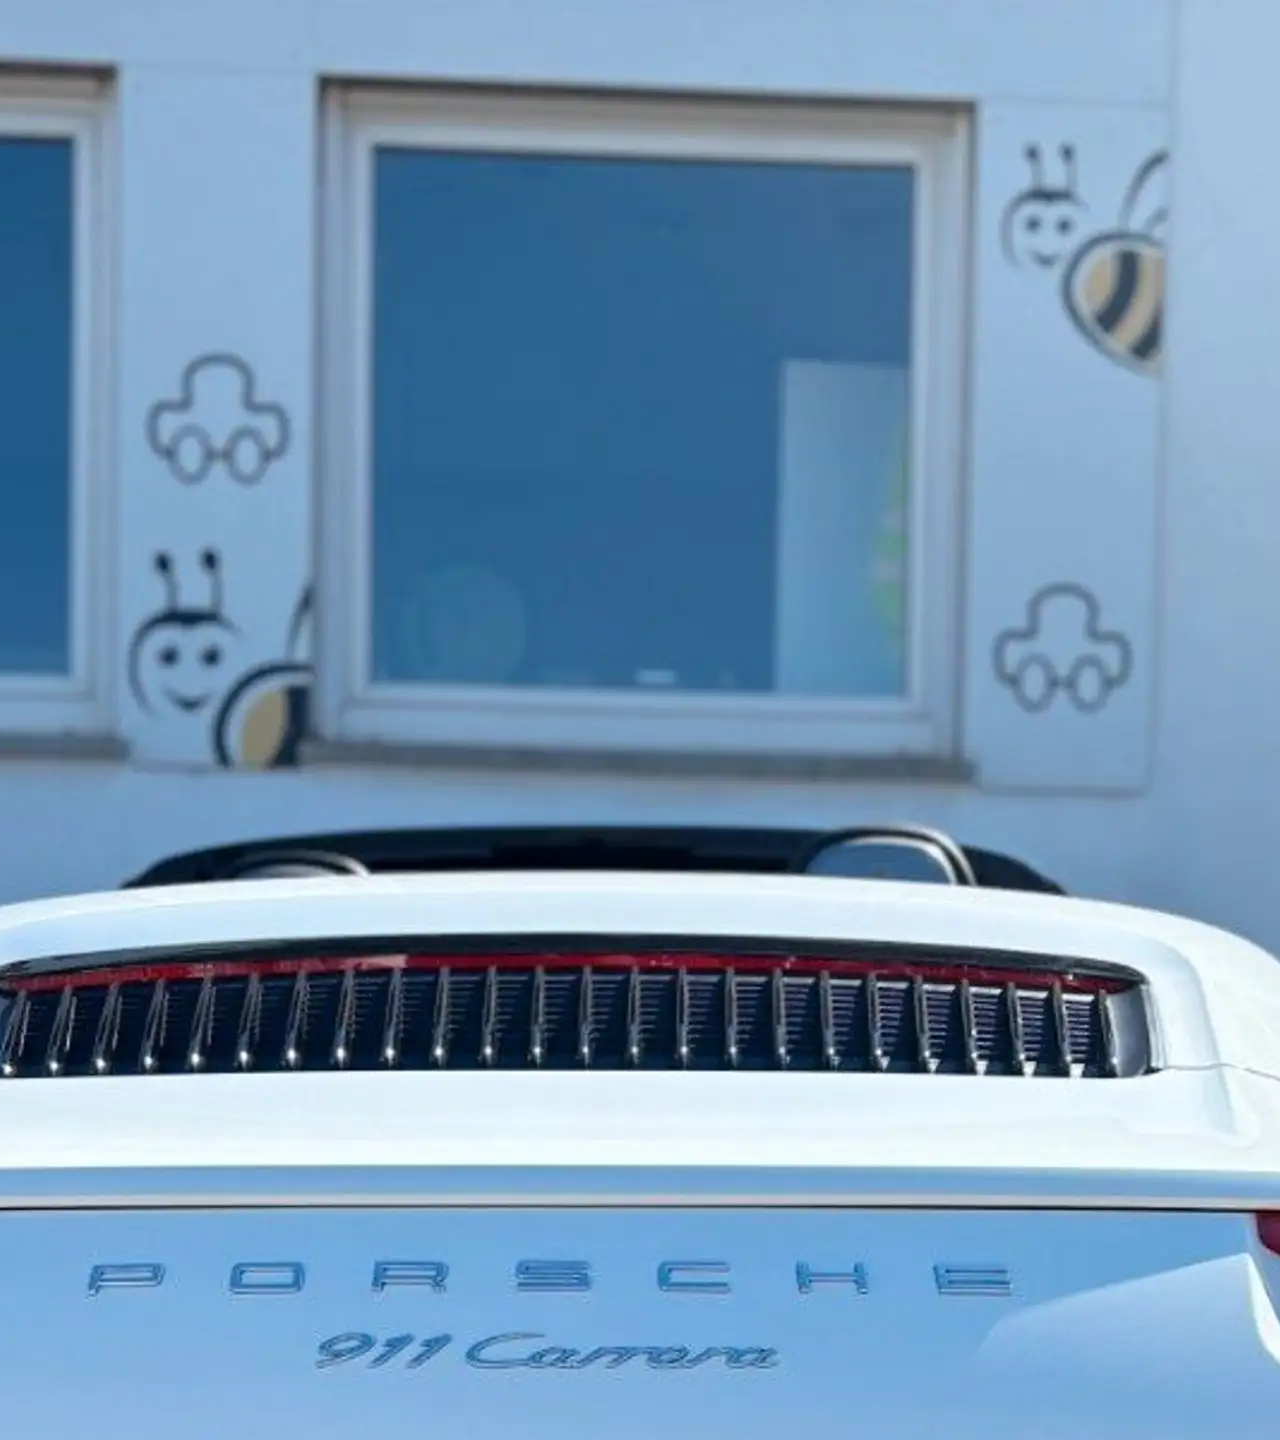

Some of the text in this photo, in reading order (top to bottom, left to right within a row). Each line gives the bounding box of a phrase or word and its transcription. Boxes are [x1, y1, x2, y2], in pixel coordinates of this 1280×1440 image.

[87, 1260, 1014, 1296] PORSCHE
[314, 1331, 782, 1370] 911 Carrera
